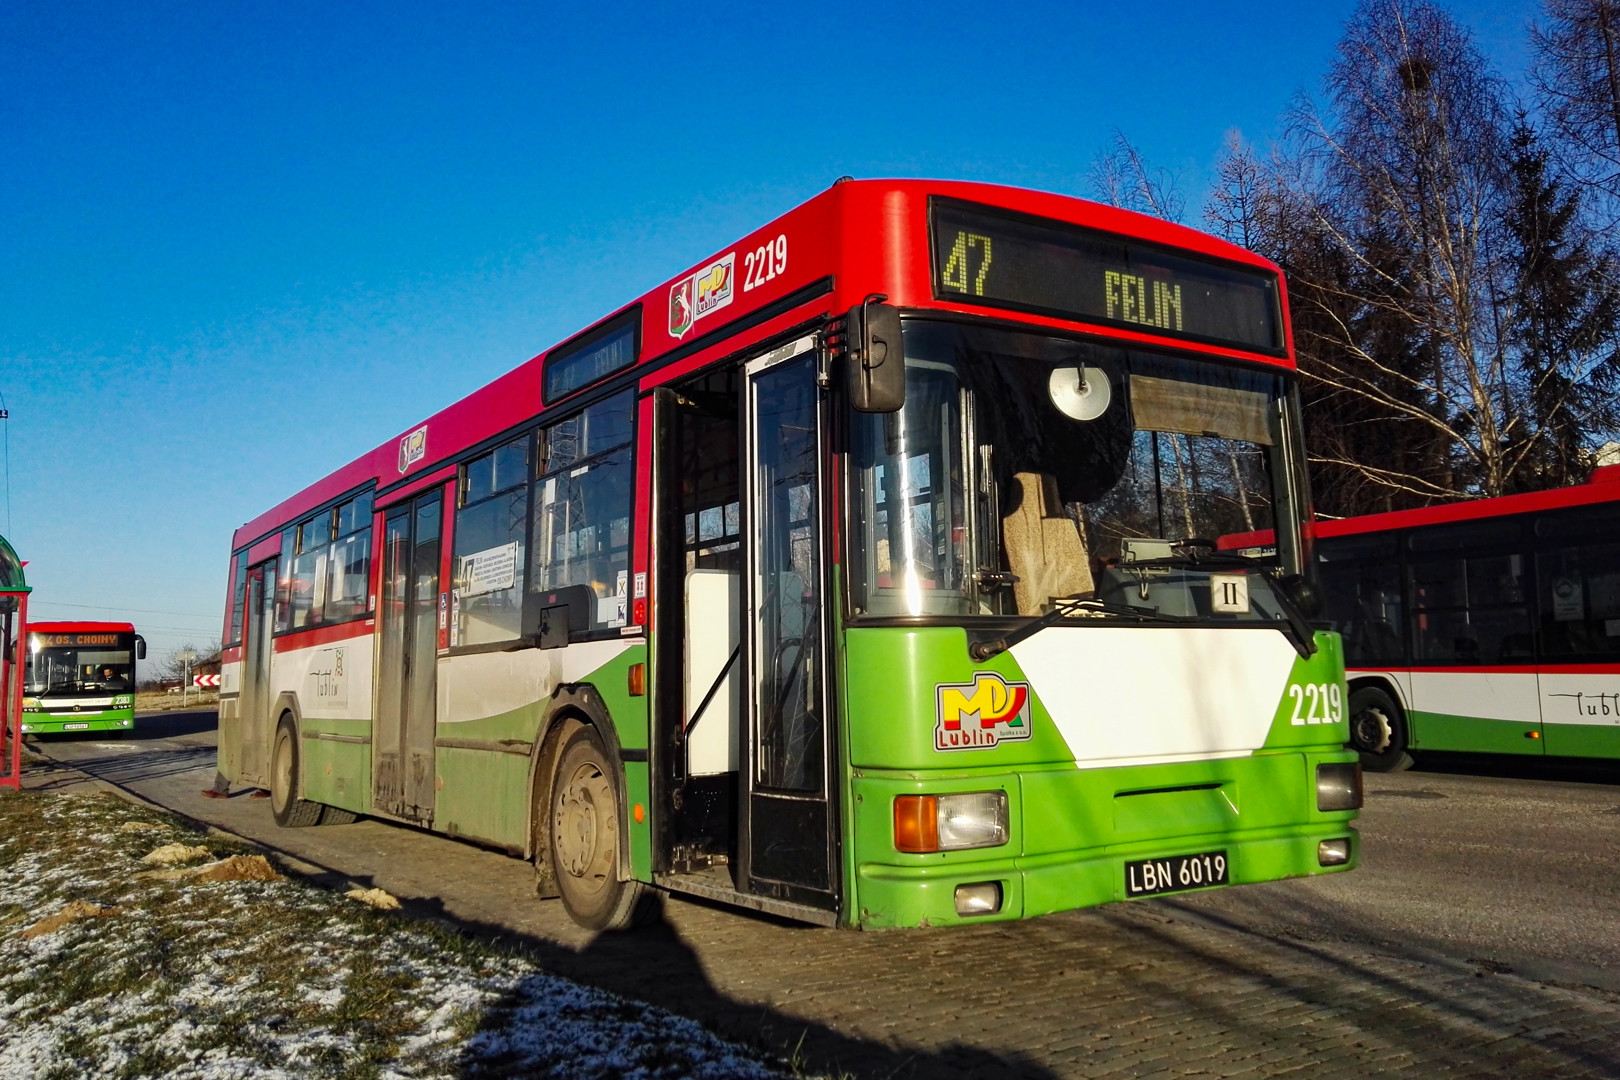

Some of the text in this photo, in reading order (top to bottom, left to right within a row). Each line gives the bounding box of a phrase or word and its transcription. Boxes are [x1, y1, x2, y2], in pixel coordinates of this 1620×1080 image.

[743, 234, 787, 292] 2219
[943, 231, 1182, 331] 47 FELIN
[461, 558, 475, 594] 47
[115, 696, 130, 704] 2383
[1289, 683, 1342, 726] 2219
[939, 728, 995, 747] Lublin
[1130, 855, 1226, 892] LBN 6019
